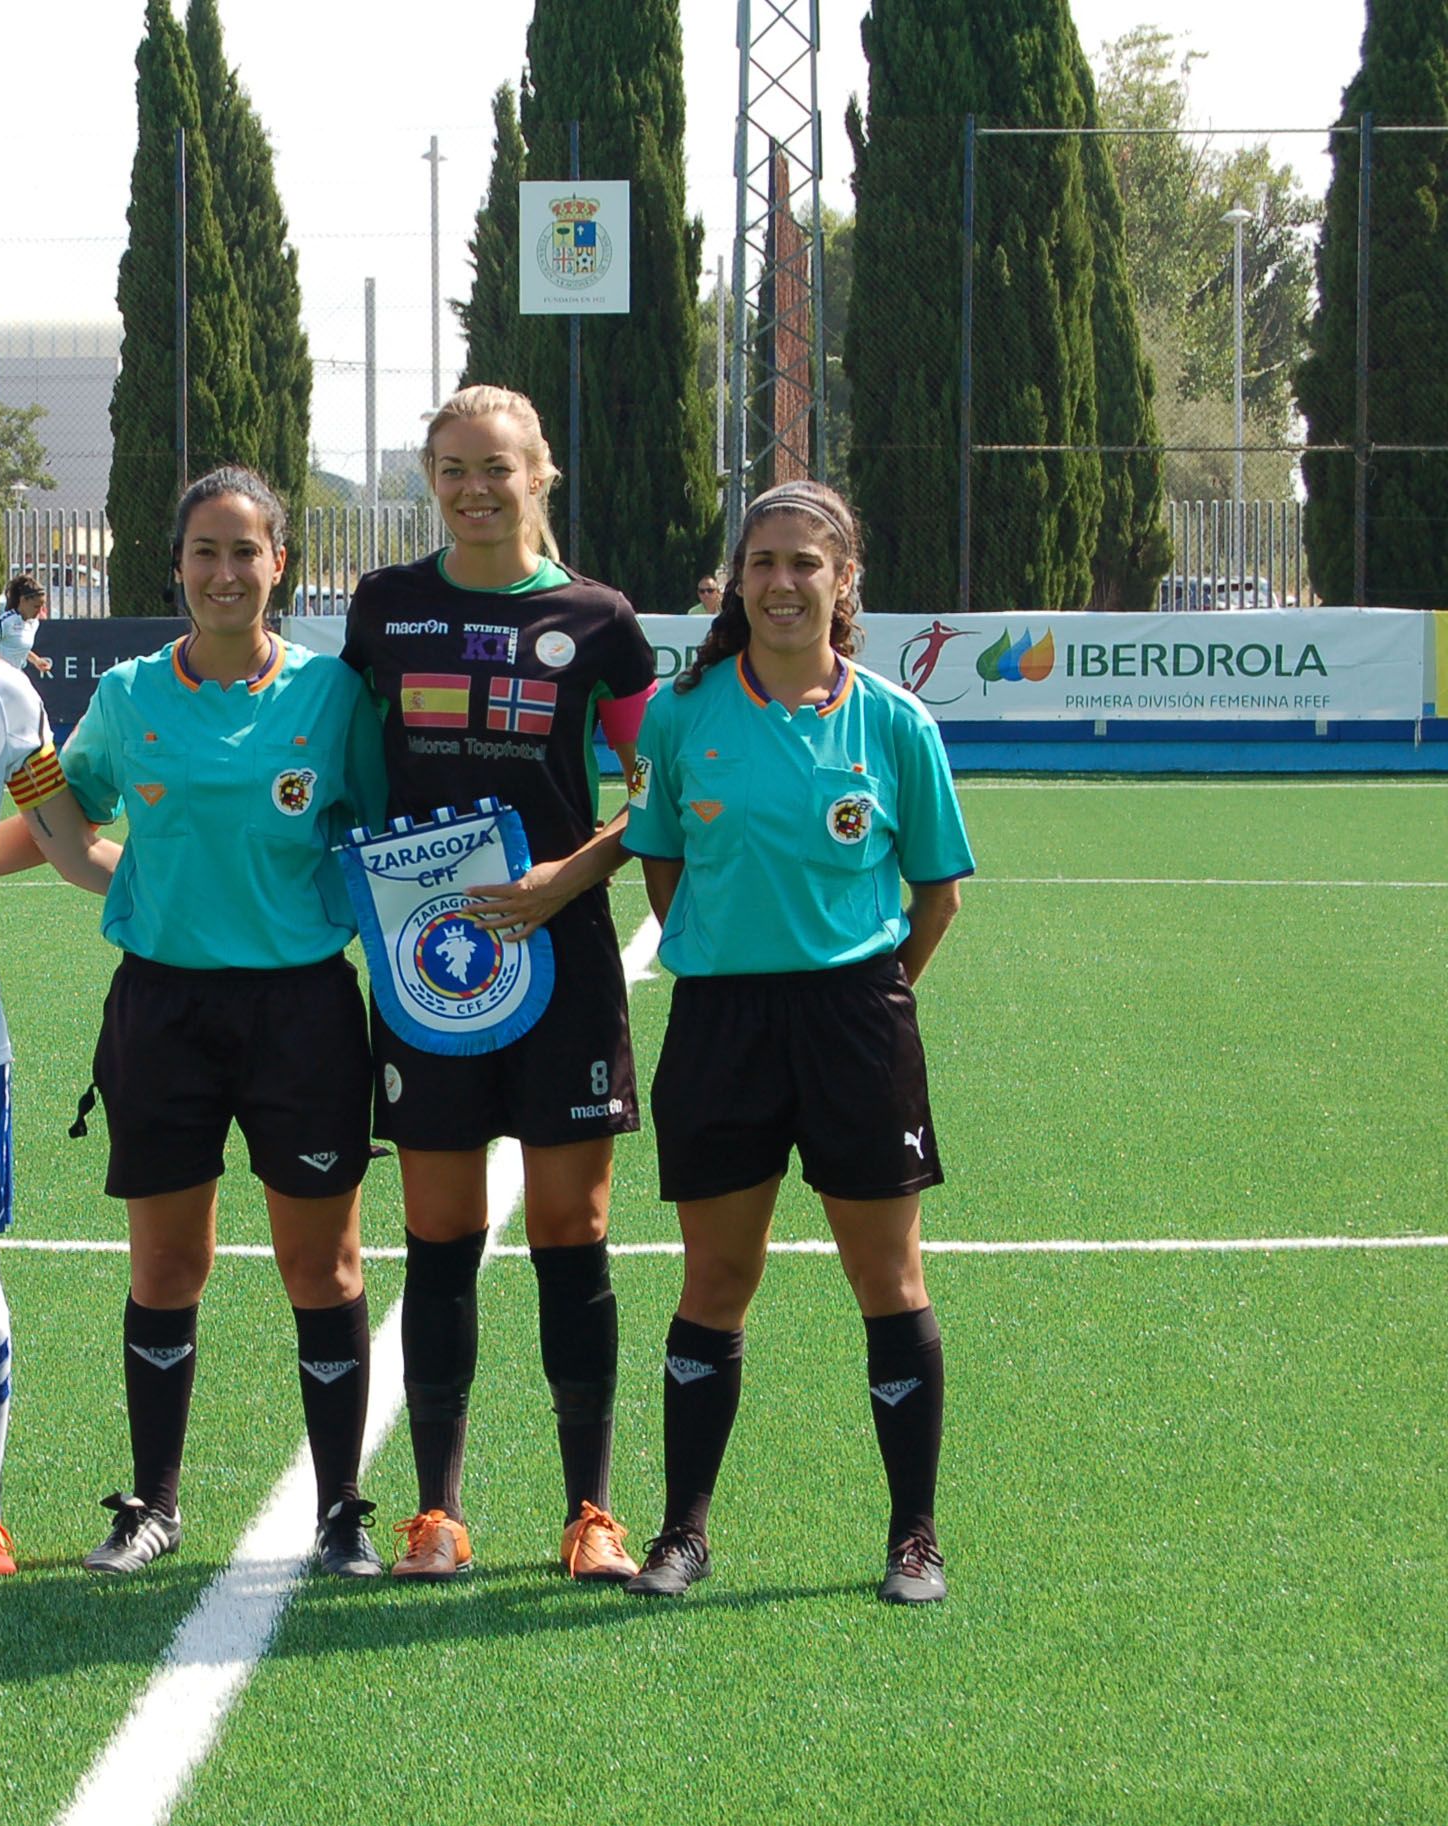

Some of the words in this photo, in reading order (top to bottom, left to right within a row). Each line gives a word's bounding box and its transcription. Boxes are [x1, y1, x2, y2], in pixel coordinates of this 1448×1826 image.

[386, 619, 448, 635] macron
[1066, 643, 1328, 677] IBERDROLA
[1066, 695, 1133, 708] PRIMERA
[1138, 691, 1204, 708] DIVISIÓN
[1210, 695, 1288, 708] FEMENINA
[1294, 695, 1330, 708] RFEF
[369, 829, 495, 873] ZARAGOZA
[418, 864, 458, 888] CFF
[414, 898, 483, 928] ZARAGO
[456, 1000, 485, 1015] CFF
[591, 1061, 609, 1096] 8
